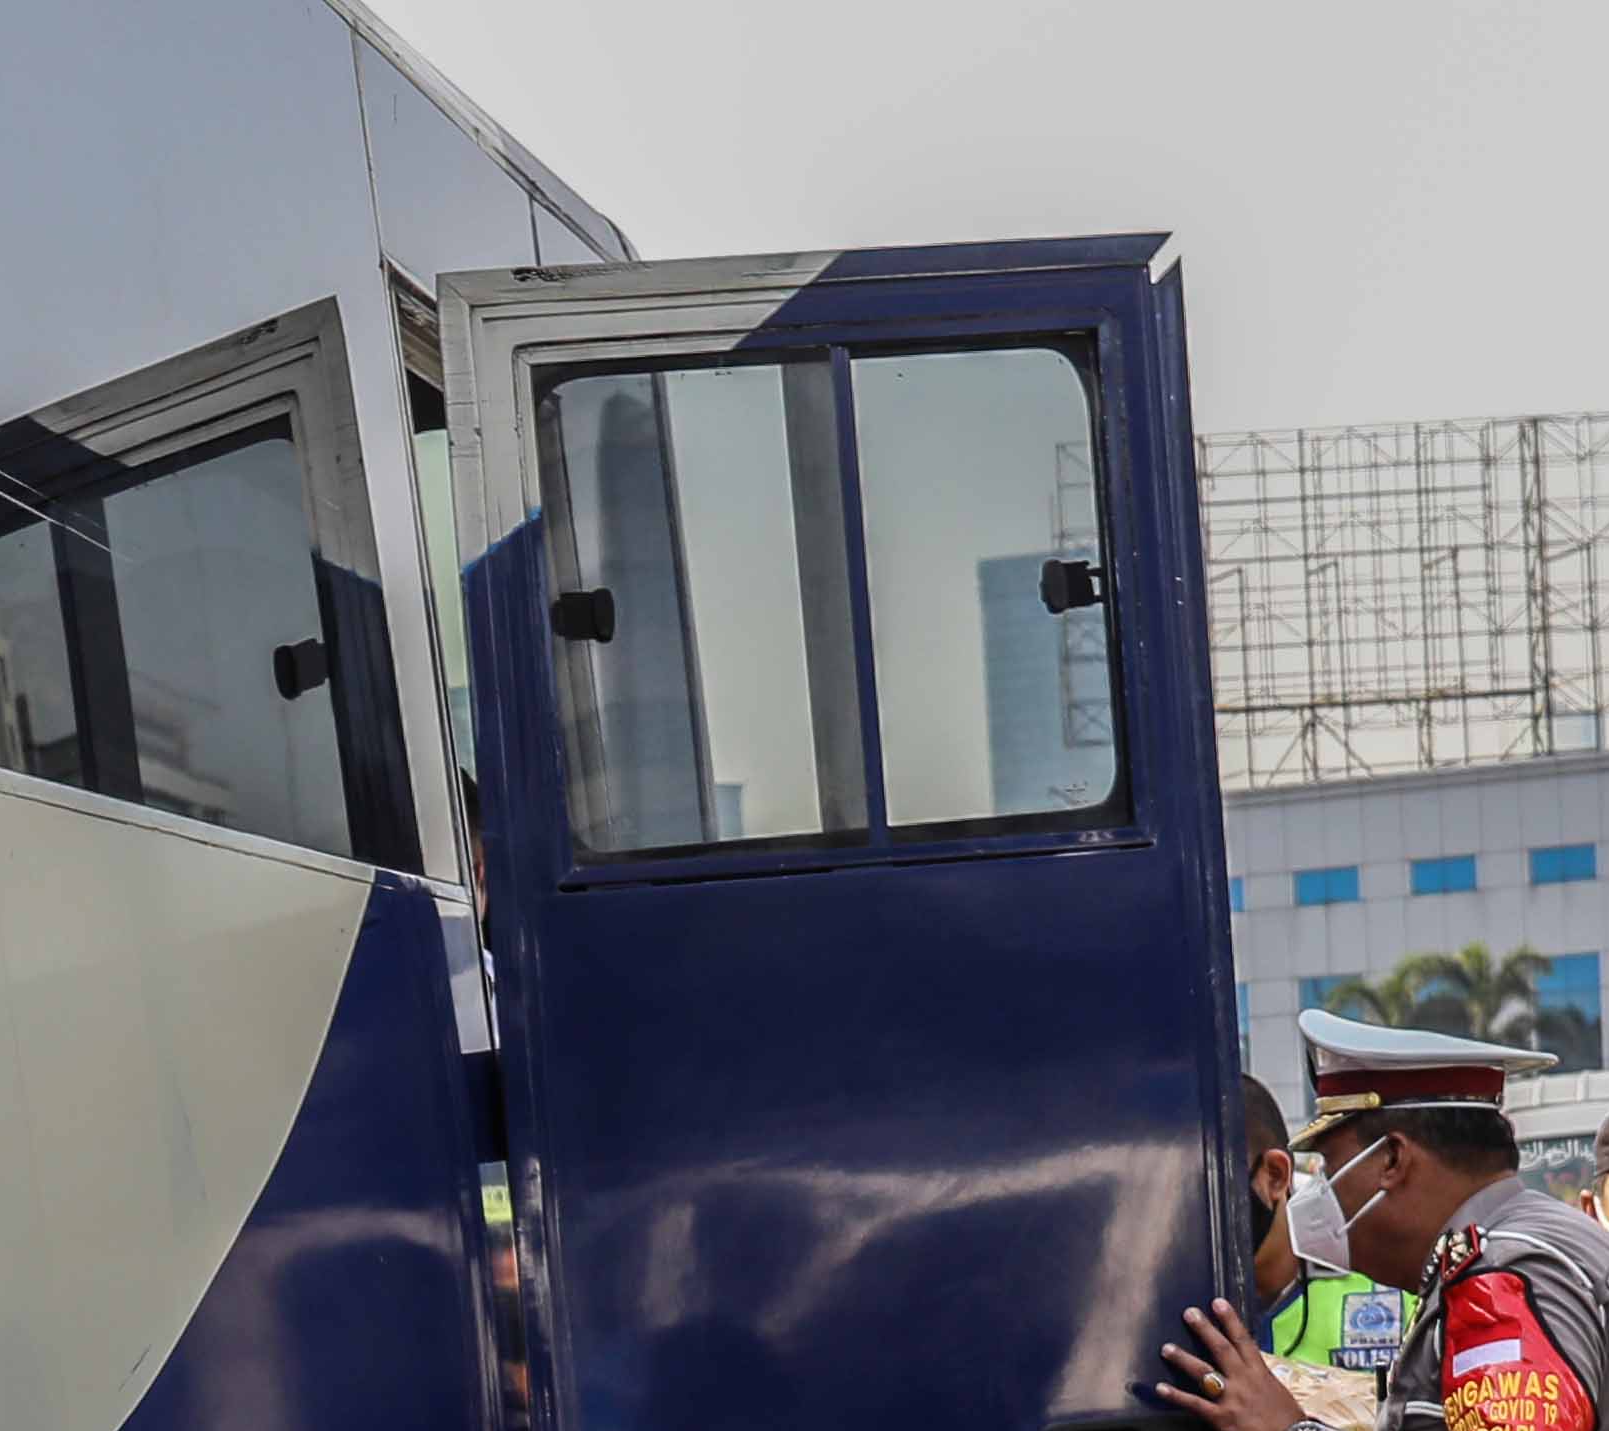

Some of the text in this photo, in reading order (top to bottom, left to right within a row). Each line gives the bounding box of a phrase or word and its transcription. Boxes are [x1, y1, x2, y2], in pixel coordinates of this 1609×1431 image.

[1445, 1371, 1559, 1427] ENGAWAS
[1489, 1399, 1535, 1422] COVID
[1543, 1404, 1557, 1425] 19
